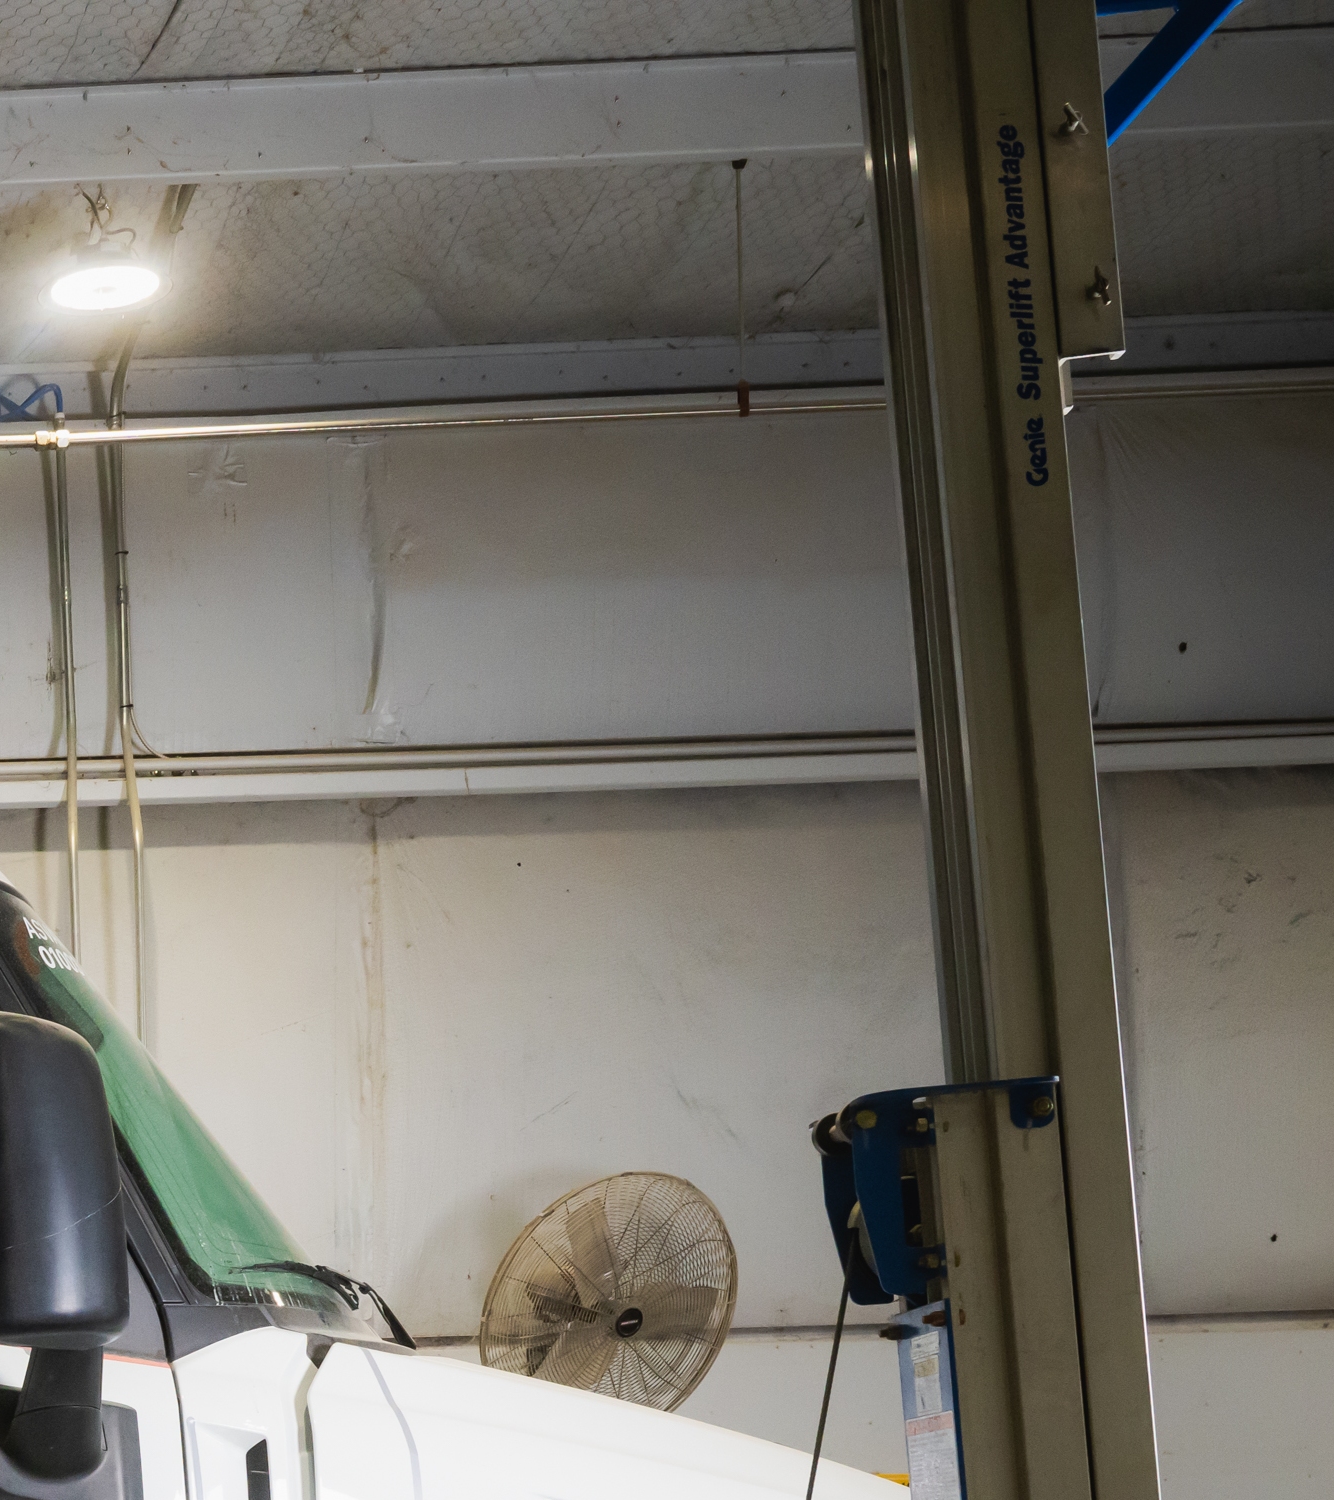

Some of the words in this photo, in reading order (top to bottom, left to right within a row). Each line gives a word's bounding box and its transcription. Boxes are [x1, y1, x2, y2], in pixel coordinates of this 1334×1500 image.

[997, 123, 1030, 270] Advantage
[1007, 277, 1042, 401] Superlift
[1024, 415, 1049, 488] Genie
